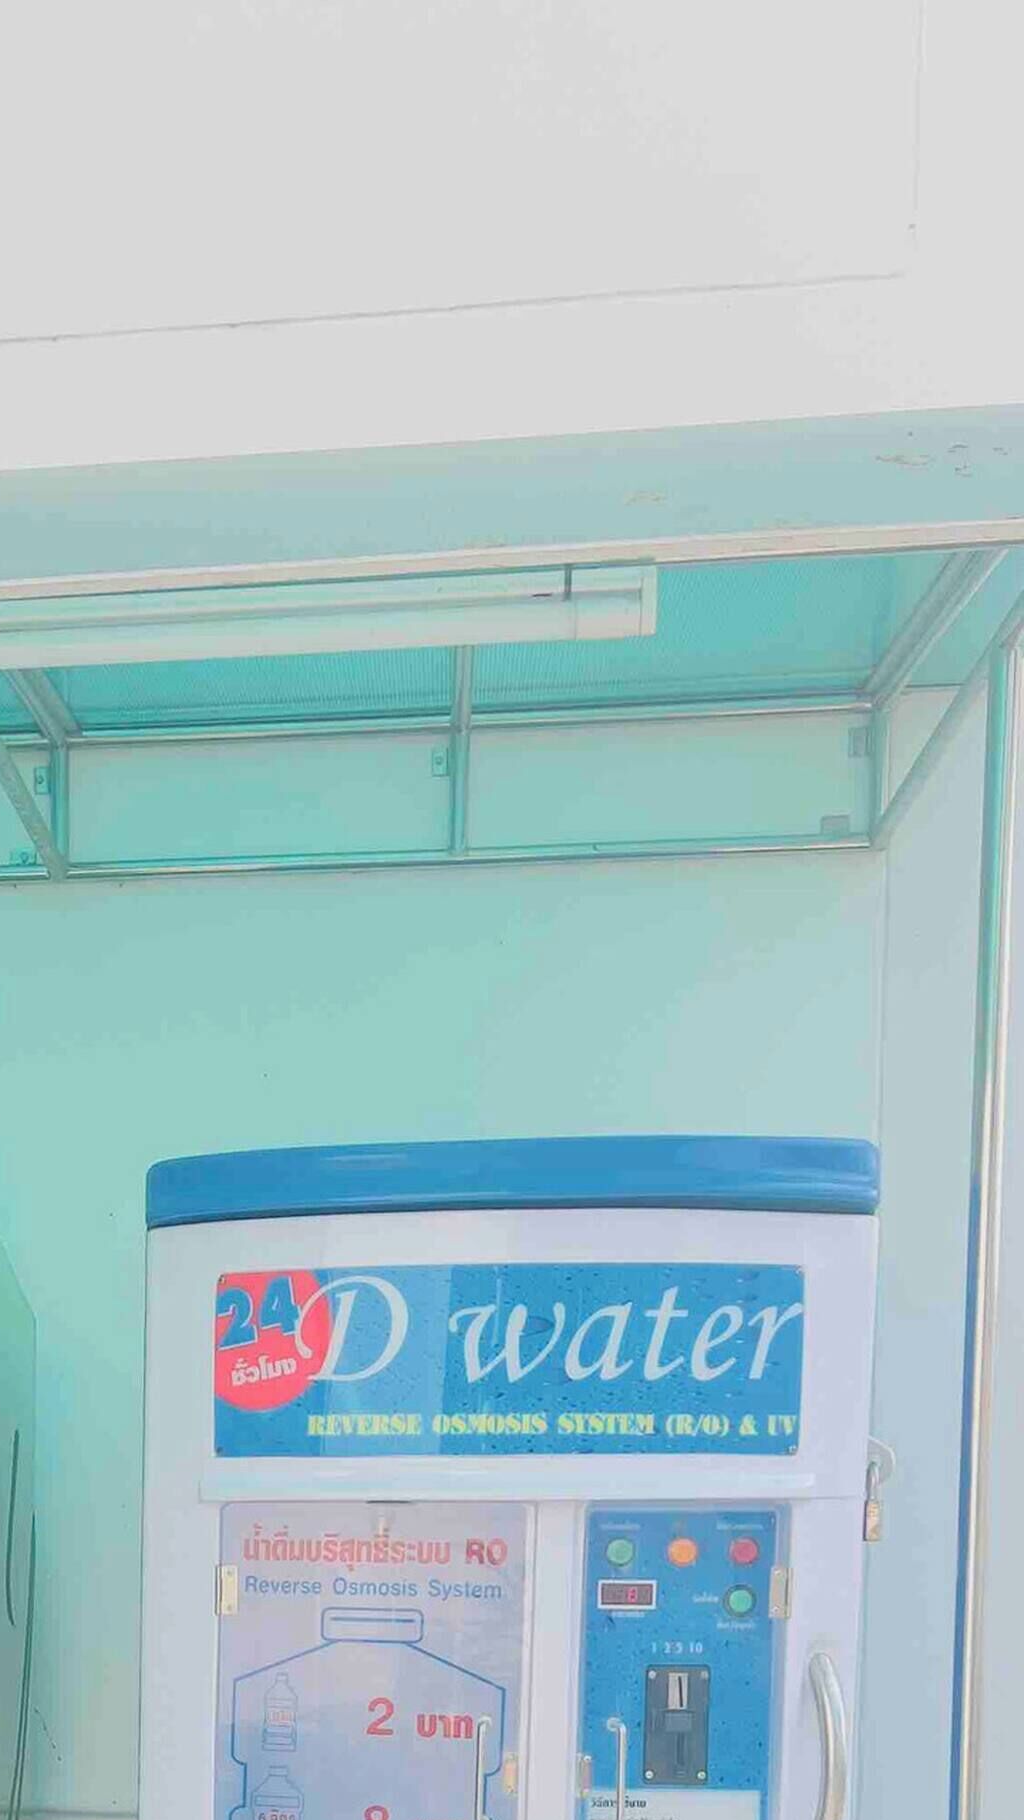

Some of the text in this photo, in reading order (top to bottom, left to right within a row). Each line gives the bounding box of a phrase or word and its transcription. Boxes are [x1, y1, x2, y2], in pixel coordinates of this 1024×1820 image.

[216, 1276, 298, 1350] 24
[294, 1275, 803, 1383] D water
[232, 1355, 297, 1386] ชั่วโมง
[308, 1413, 797, 1436] REVERSE OSMOSIS SYSTEM (R/O) & UV
[465, 1538, 508, 1565] RO
[245, 1576, 502, 1601] Reverse Osmosis System
[366, 1697, 474, 1739] 2 บาท
